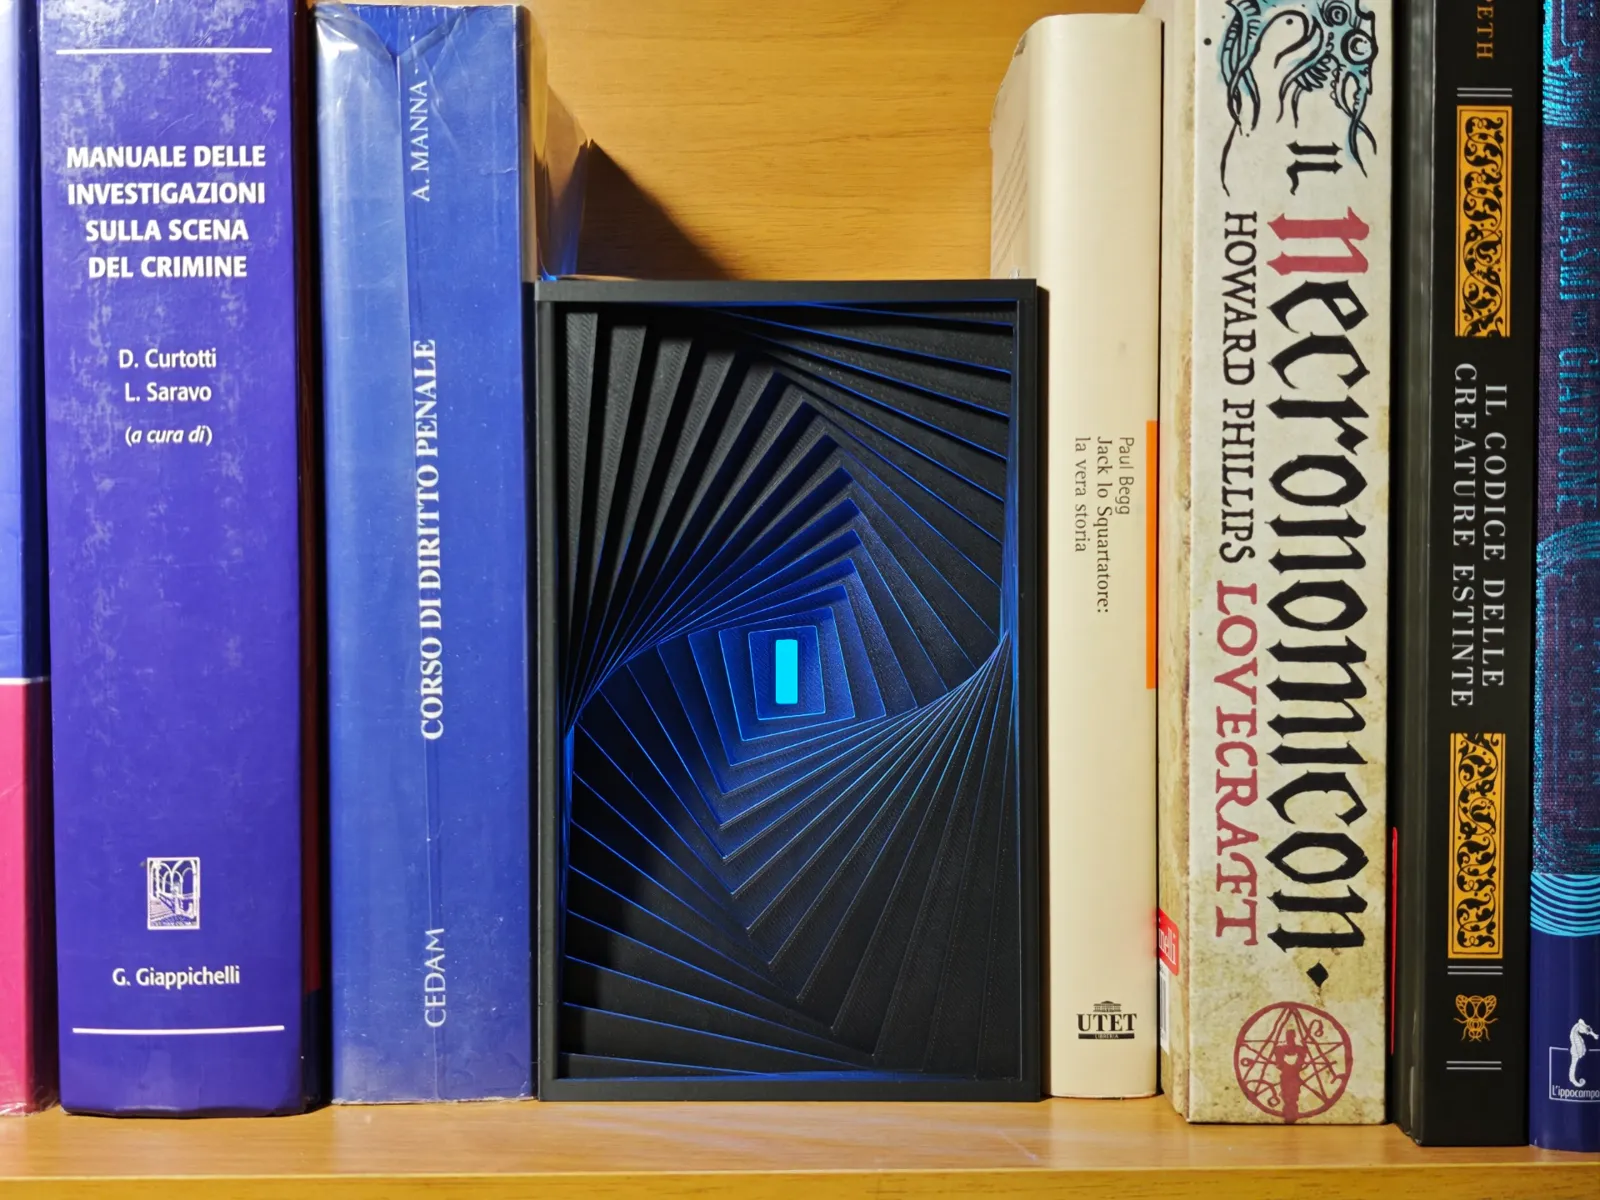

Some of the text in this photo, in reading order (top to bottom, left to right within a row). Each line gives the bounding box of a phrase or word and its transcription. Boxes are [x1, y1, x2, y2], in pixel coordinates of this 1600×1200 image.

[1477, 0, 1494, 58] ETH
[66, 145, 266, 168] MANUALE DELLE
[408, 79, 431, 202] A. MANNA
[67, 181, 266, 205] INVESTIGAZIONI
[85, 218, 249, 242] SULLA SCENA
[88, 255, 248, 278] DEL CRIMINE
[118, 347, 217, 369] D. Curtotti
[124, 382, 212, 402] L. Saravo
[124, 424, 213, 446] (a cura di)
[1075, 437, 1091, 552] la vera storia
[1115, 437, 1135, 515] Paul Begg
[412, 339, 443, 741] CORSO DI DIRITTO PENALE
[1093, 436, 1113, 613] Jack lo Squartatore:
[1451, 363, 1477, 707] CREATURE ESTINTE
[1482, 385, 1508, 687] IL CODICE DELLE
[1214, 211, 1259, 946] HOWARD PHILLIPS LOVECRAFT
[112, 965, 240, 990] G. Giappichelli
[424, 927, 447, 1028] CEDAM
[1077, 1017, 1137, 1032] UTET
